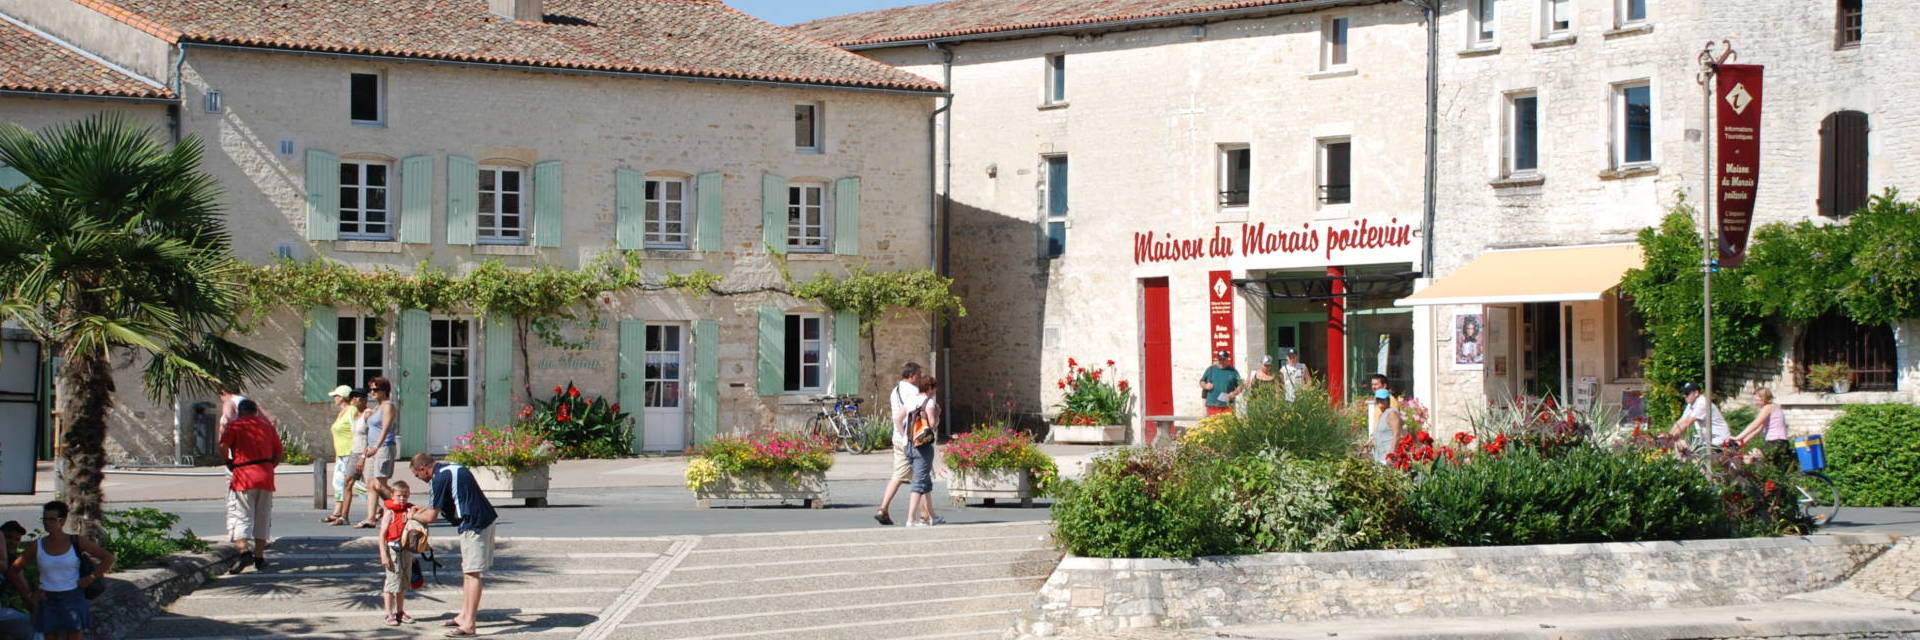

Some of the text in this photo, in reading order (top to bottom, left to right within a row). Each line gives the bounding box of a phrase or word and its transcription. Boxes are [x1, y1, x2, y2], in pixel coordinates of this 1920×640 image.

[1726, 163, 1749, 173] Maison
[1731, 176, 1754, 186] Marais
[1134, 218, 1410, 265] Maison du Marais poitevin
